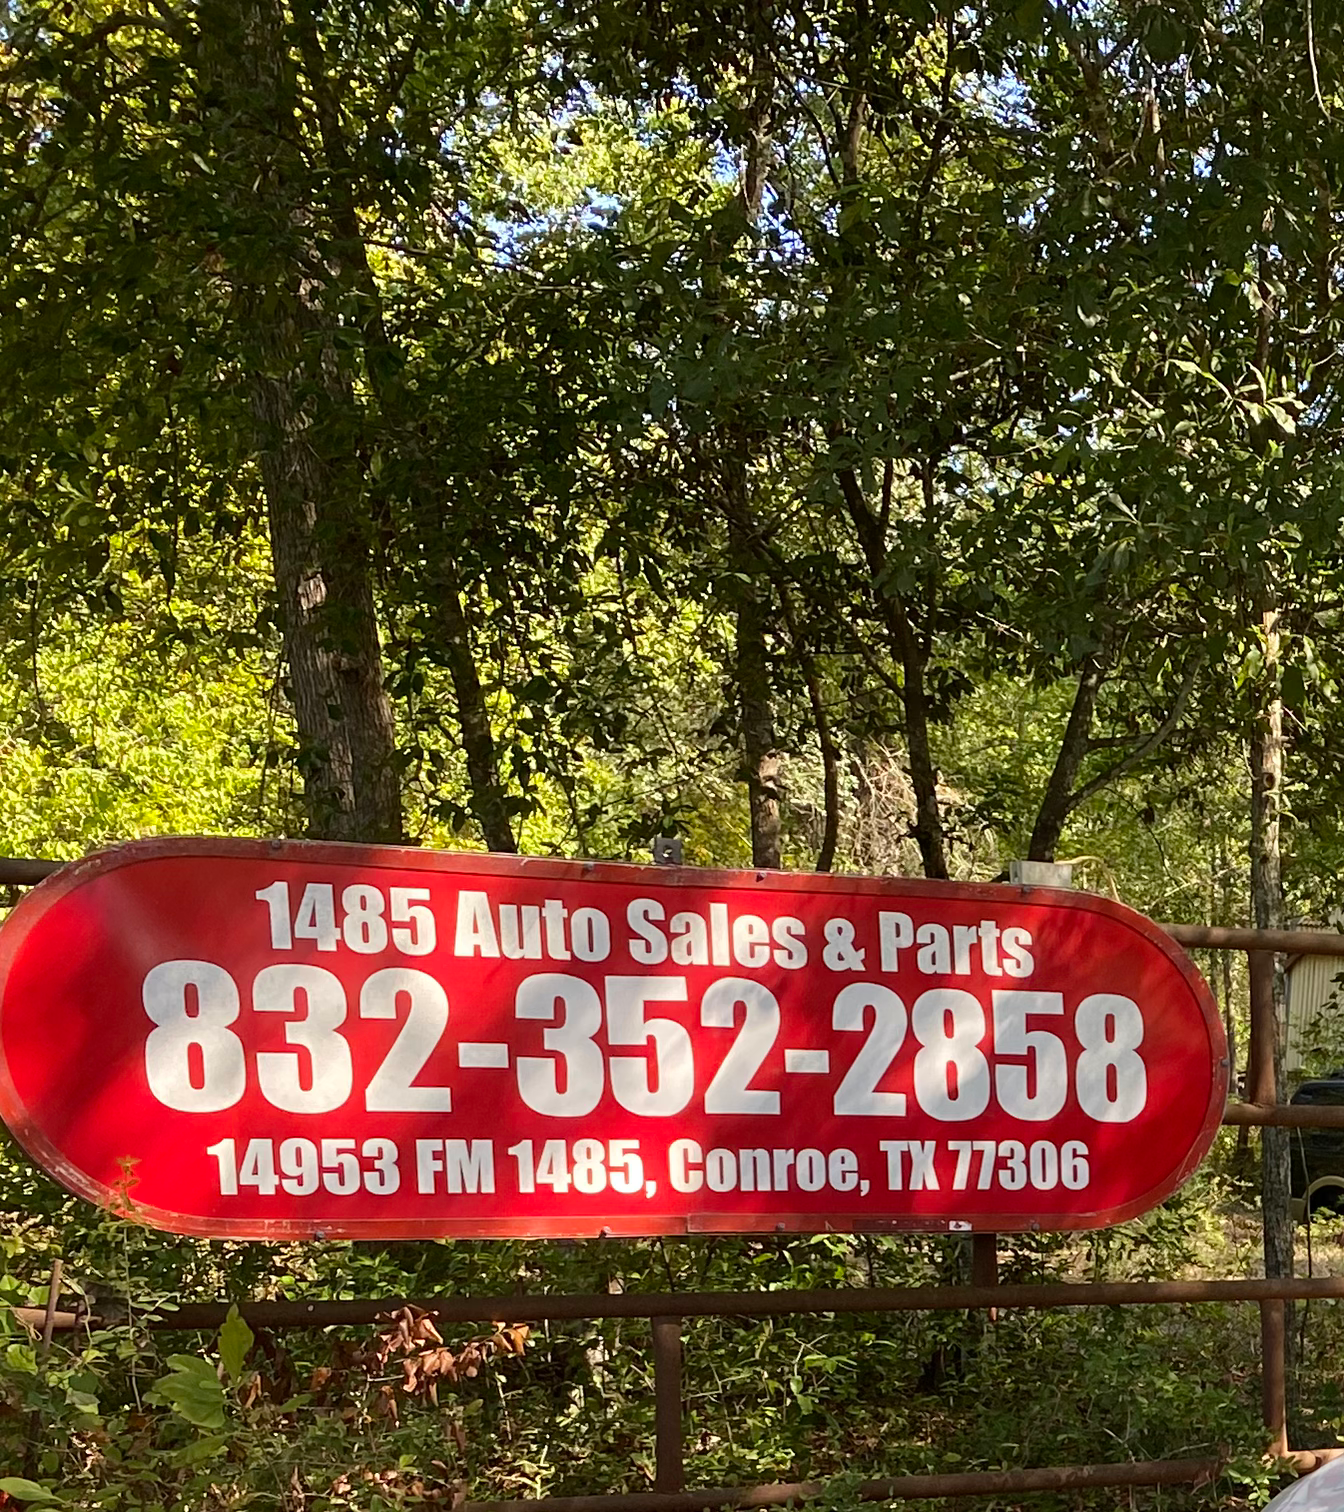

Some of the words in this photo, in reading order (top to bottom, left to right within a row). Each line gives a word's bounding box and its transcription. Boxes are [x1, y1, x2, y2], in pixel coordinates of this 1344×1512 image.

[256, 881, 437, 956] 1485
[454, 889, 610, 962] Auto
[627, 898, 808, 970] Sales
[823, 917, 866, 971] &
[878, 910, 1034, 978] Parts
[142, 959, 1148, 1123] 832-352-2858
[207, 1137, 400, 1196] 14953
[416, 1138, 496, 1195] FM
[508, 1138, 657, 1200] 1485,
[668, 1138, 870, 1197] Conroe,
[880, 1140, 941, 1191] TX
[948, 1139, 1090, 1191] 77306
